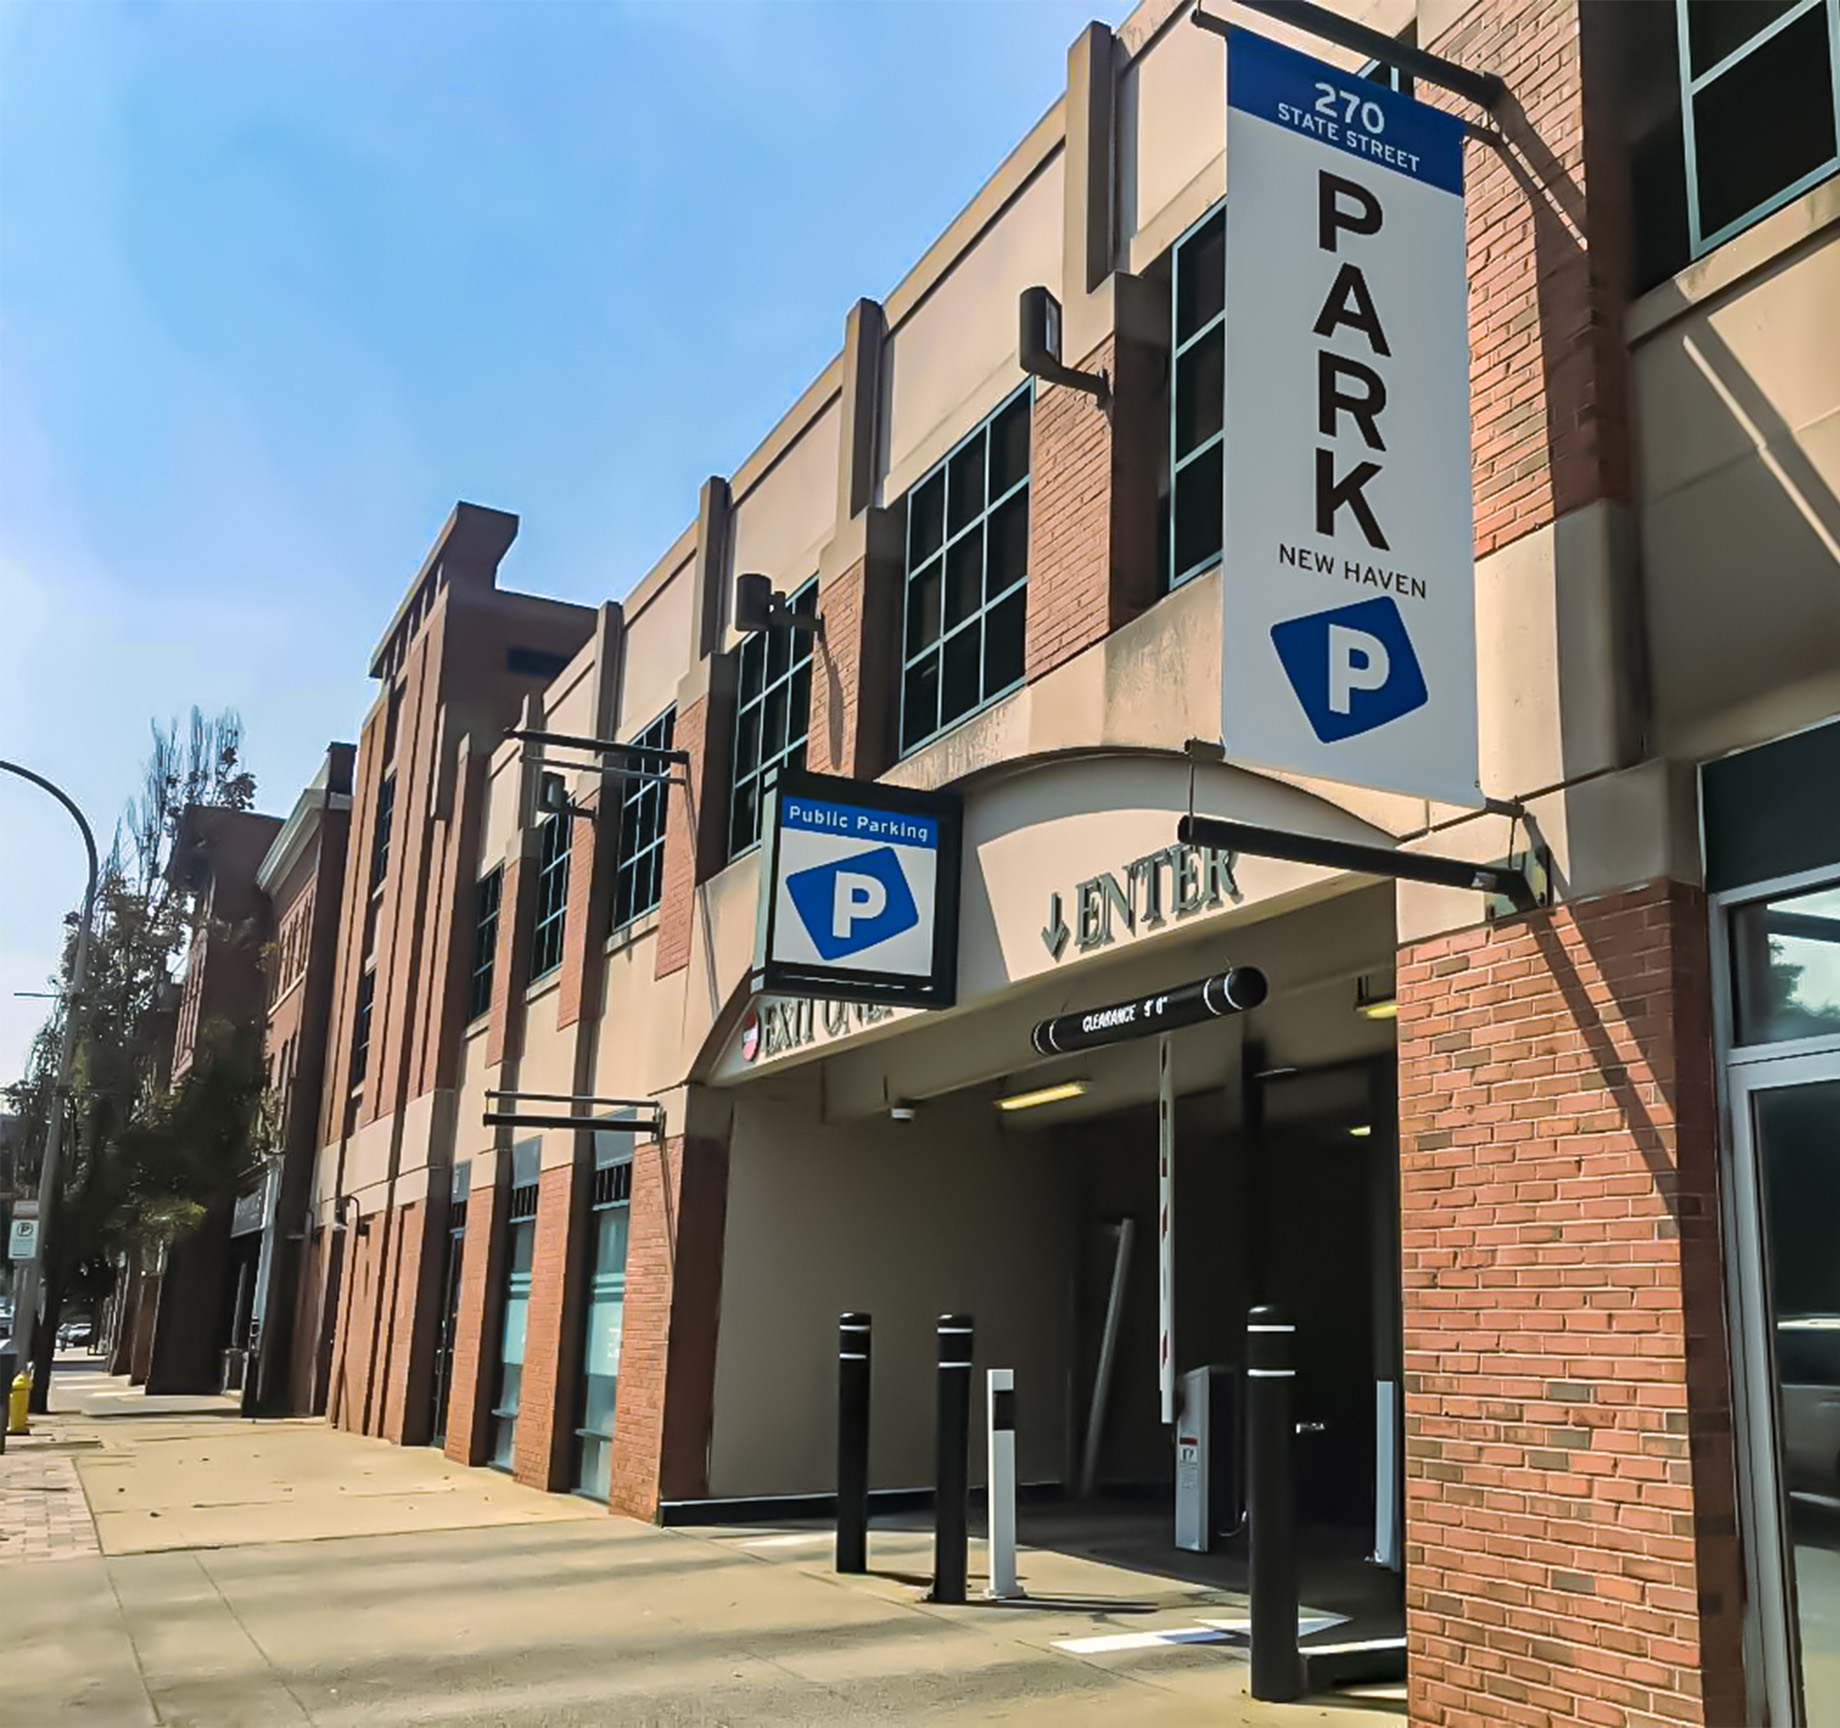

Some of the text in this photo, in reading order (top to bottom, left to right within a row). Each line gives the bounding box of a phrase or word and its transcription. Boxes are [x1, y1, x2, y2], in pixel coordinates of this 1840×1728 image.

[1278, 102, 1420, 172] STATE STREET
[1315, 82, 1385, 134] 270
[1313, 169, 1391, 551] PARK
[1279, 543, 1426, 599] NEW HAVEN
[1328, 623, 1390, 715] P
[789, 805, 928, 842] Public Parking
[832, 870, 888, 939] P
[1075, 843, 1242, 950] ENTER
[761, 999, 815, 1056] EXIT
[1082, 1003, 1137, 1032] CLEARANCE
